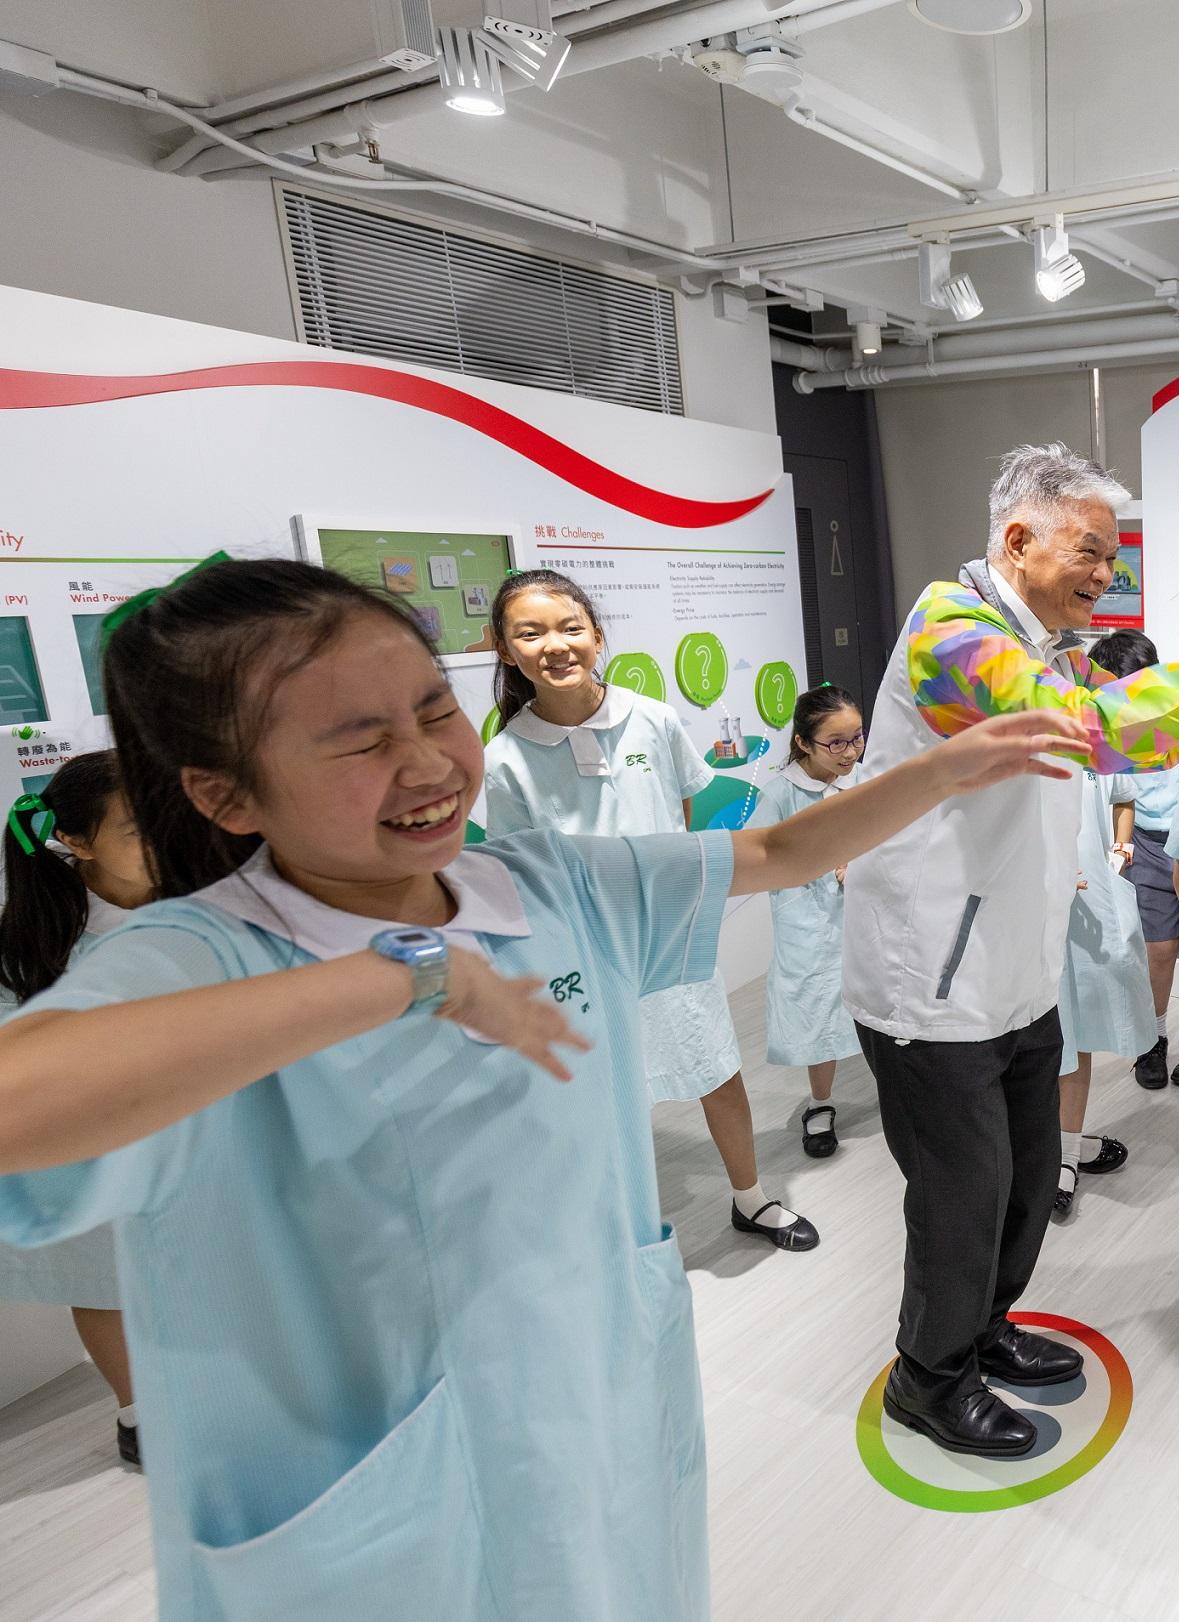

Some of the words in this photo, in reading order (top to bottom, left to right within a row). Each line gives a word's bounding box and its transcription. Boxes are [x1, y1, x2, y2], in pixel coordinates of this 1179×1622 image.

[535, 525, 557, 538] 挑戰
[561, 526, 605, 541] Challenges
[68, 581, 94, 591] 風能
[5, 594, 28, 605] (PV)
[70, 593, 99, 603] Wind
[17, 741, 72, 756] 轉廢為能
[625, 753, 647, 767] BR
[549, 971, 584, 1003] BR
